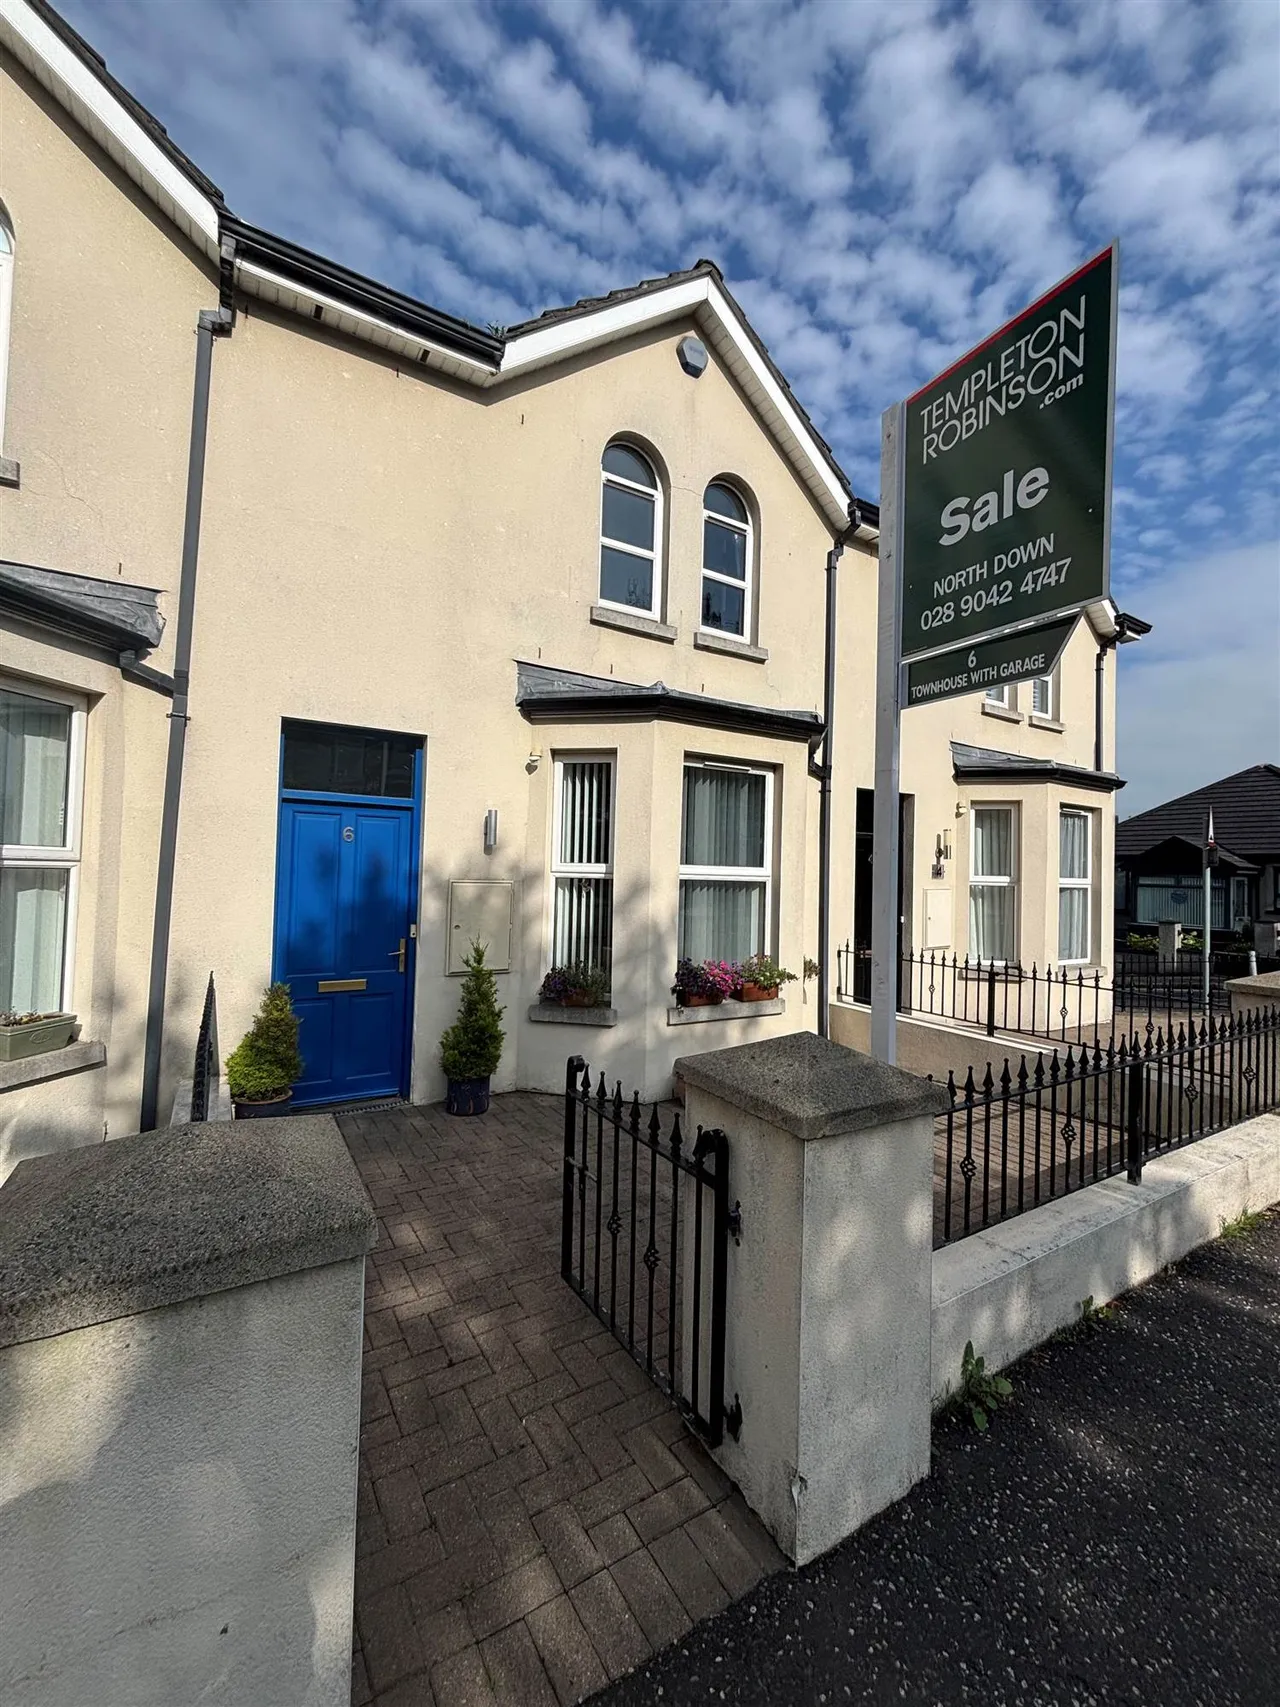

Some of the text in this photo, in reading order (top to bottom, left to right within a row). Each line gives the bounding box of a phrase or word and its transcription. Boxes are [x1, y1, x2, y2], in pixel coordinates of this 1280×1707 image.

[920, 294, 1086, 435] TEMPLETON
[1039, 373, 1084, 410] .com
[922, 331, 1085, 465] ROBINSON
[938, 467, 1049, 546] Sale
[920, 557, 1072, 631] 028 9042 4747
[933, 533, 1054, 599] NORTH DOWN
[911, 653, 1045, 699] TOWNHOUSE WITH GARAGE
[967, 650, 977, 668] 6
[343, 826, 354, 842] 6
